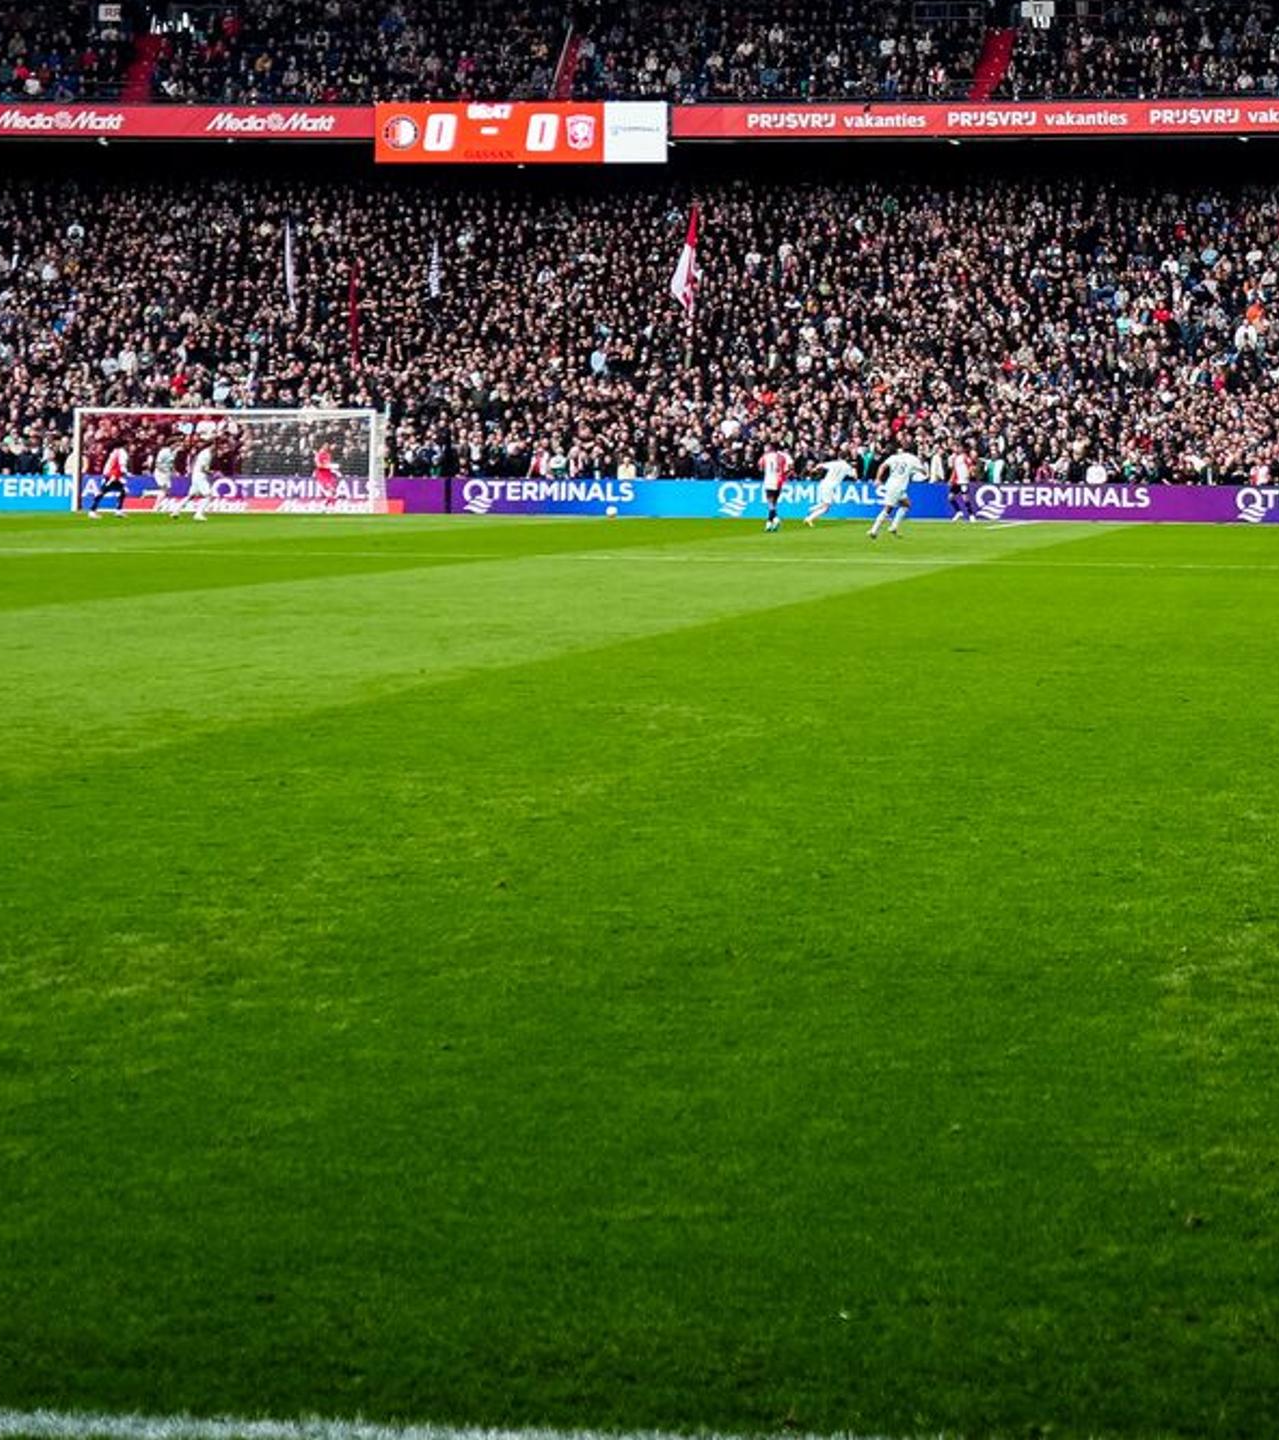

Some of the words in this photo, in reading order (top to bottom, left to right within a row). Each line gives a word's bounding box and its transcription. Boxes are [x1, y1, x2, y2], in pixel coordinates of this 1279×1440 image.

[423, 114, 457, 151] 0
[526, 114, 559, 151] 0
[843, 111, 926, 128] vakanties
[1045, 109, 1128, 126] vakanties
[463, 479, 634, 514] QTERMINALS
[975, 485, 1150, 520] QTERMINALS
